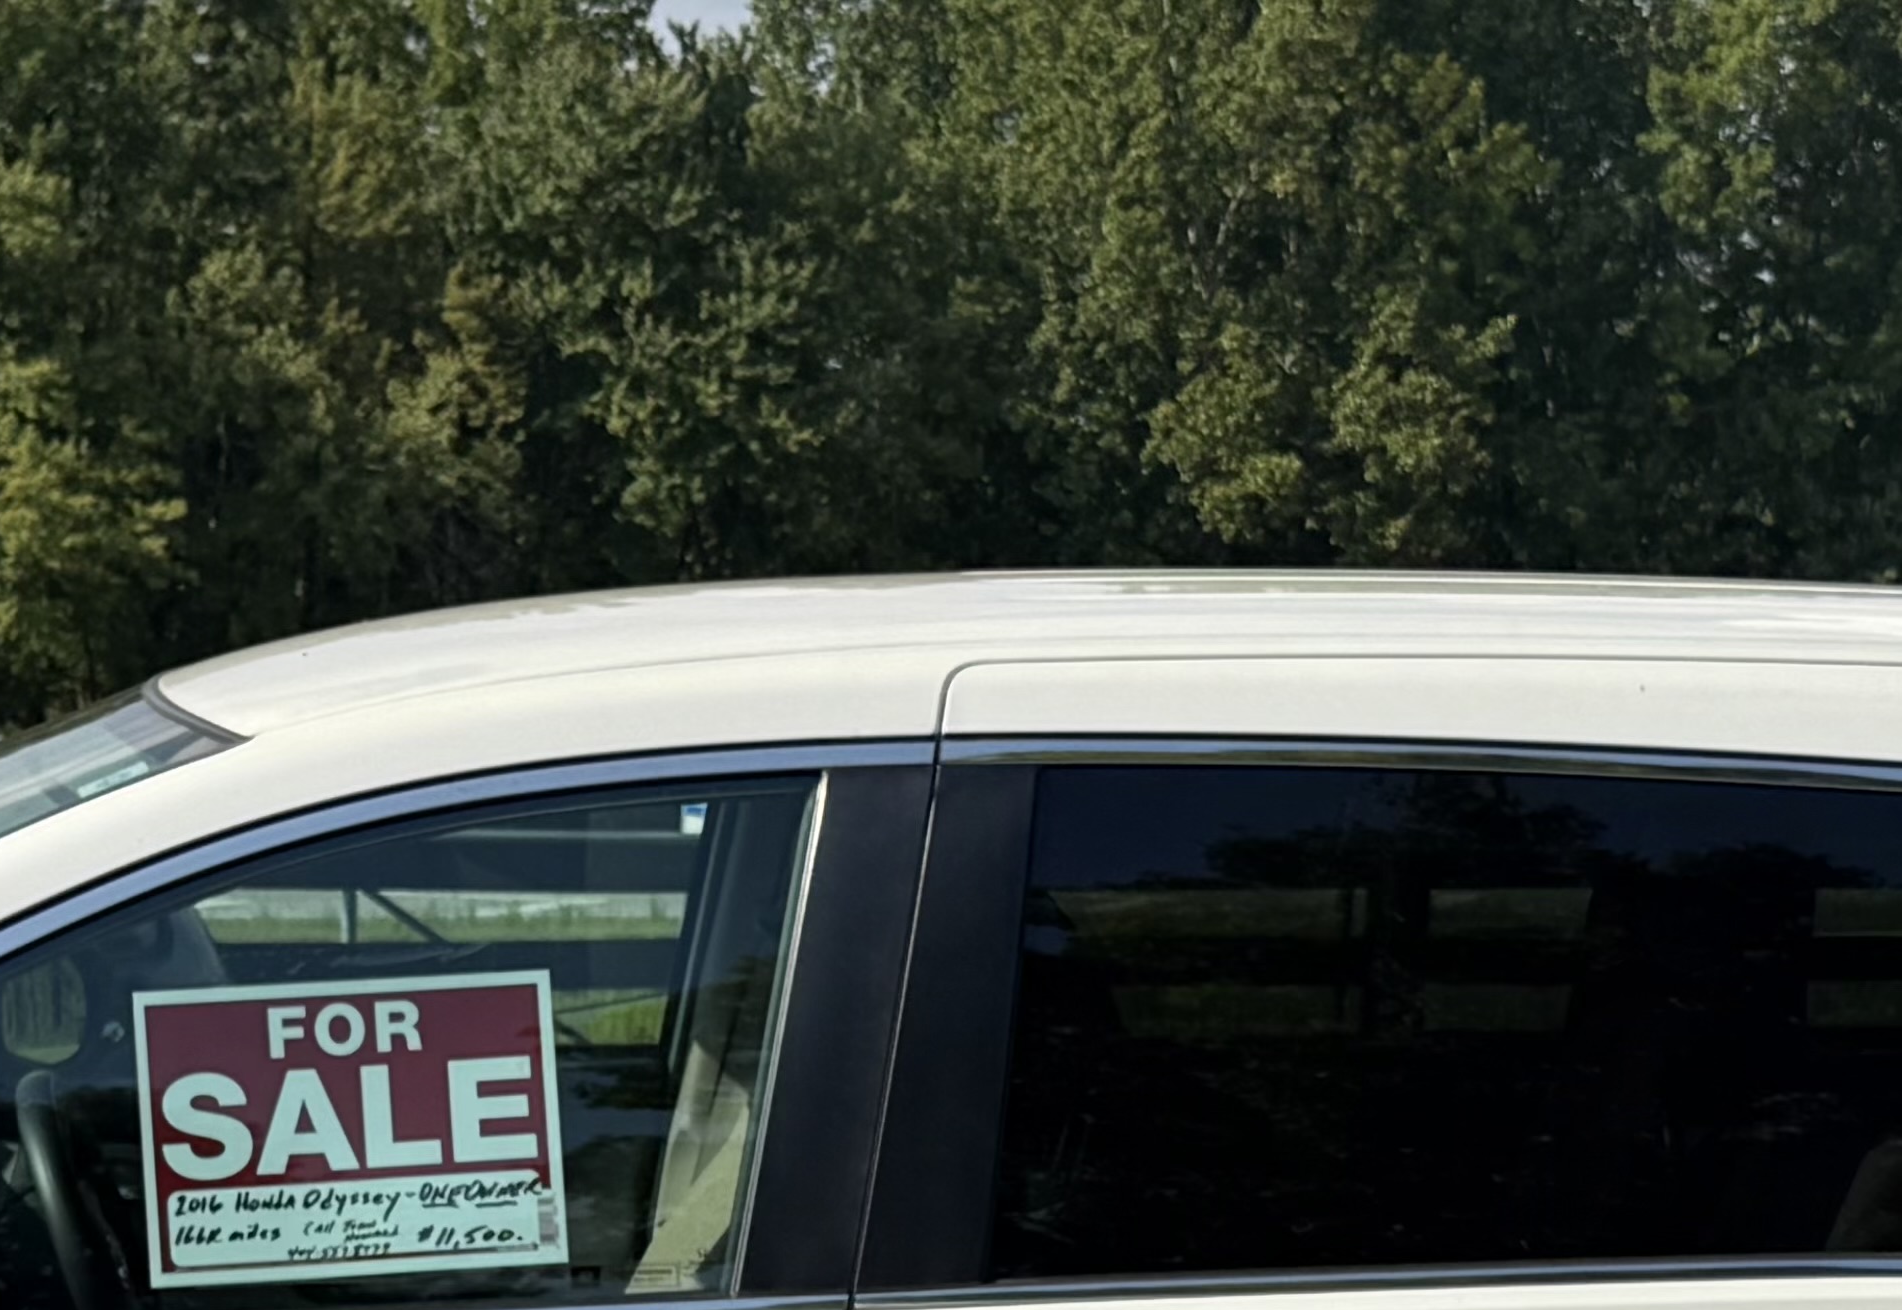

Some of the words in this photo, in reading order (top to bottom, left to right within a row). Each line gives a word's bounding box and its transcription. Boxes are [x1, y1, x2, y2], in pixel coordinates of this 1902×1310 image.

[266, 999, 423, 1060] FOR
[161, 1055, 539, 1181] SALE
[175, 1194, 223, 1217] 2016
[302, 1187, 401, 1222] Odyssey
[228, 1222, 281, 1242] miles
